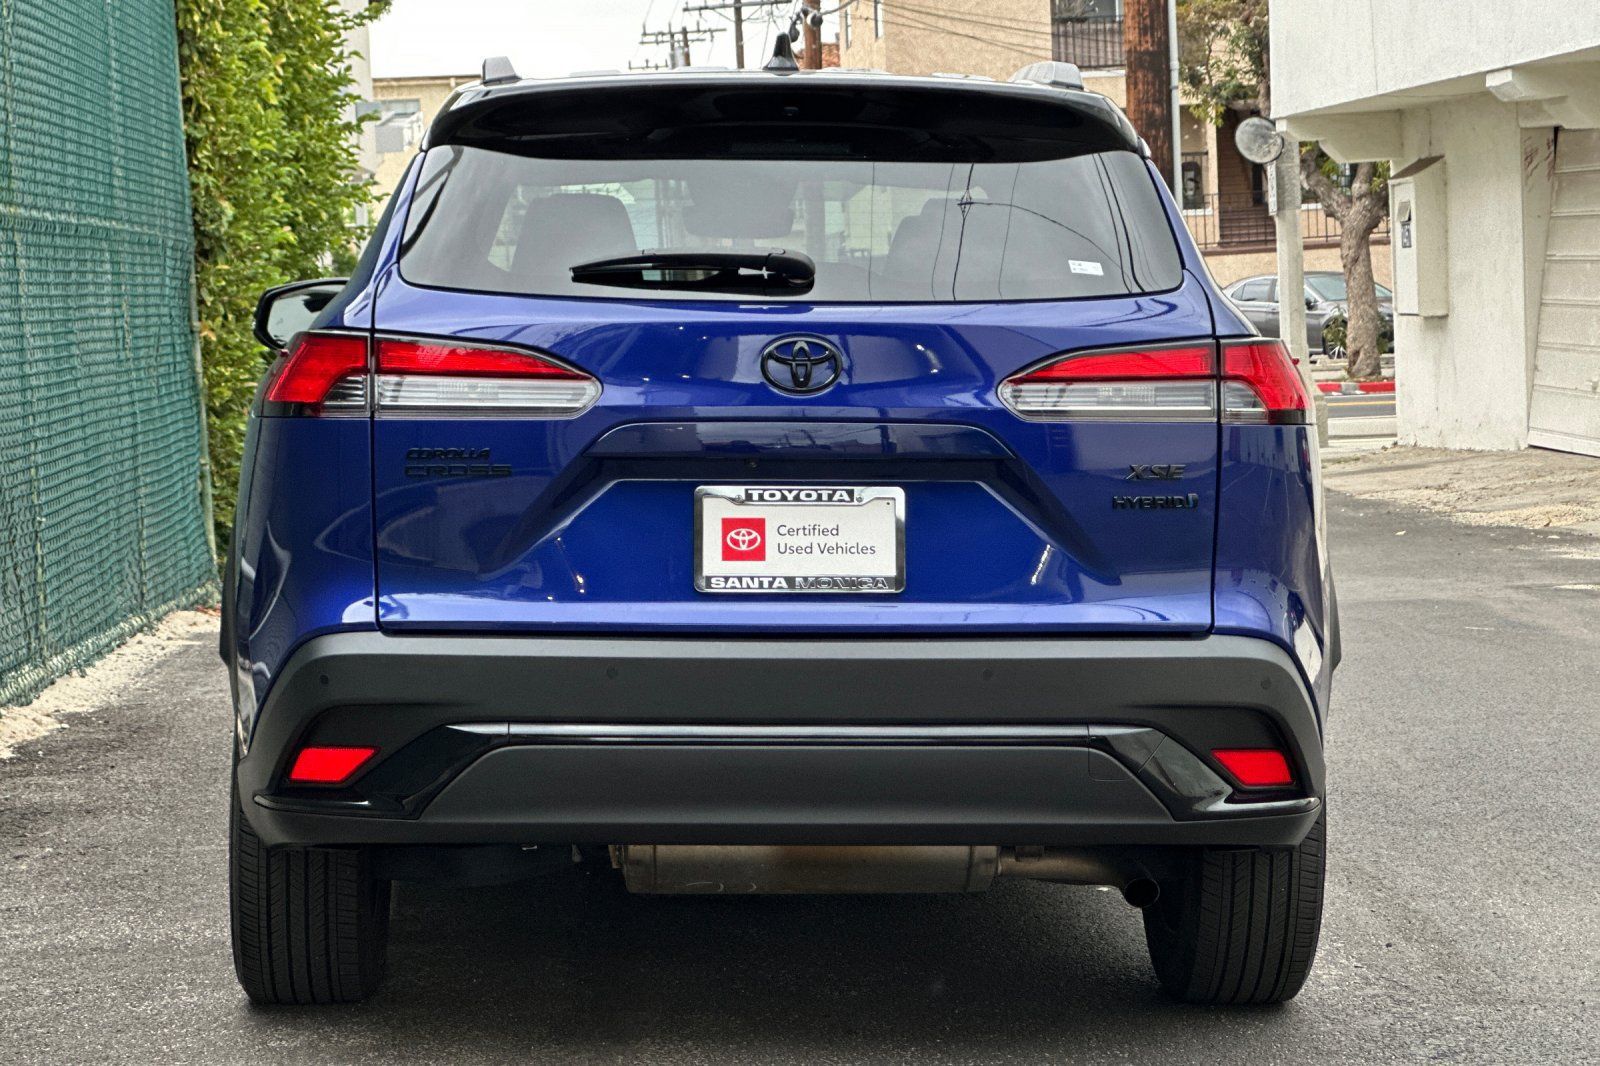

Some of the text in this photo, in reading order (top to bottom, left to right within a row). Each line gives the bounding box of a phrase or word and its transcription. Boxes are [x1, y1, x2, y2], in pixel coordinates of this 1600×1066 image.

[406, 447, 491, 459] COROLLA
[404, 464, 512, 477] CROSS
[1125, 464, 1186, 480] XSE
[748, 489, 850, 501] TOYOTA
[1112, 495, 1184, 509] HYBRID
[776, 523, 840, 537] Certified
[777, 542, 876, 555] Used Vehicles
[710, 576, 889, 590] SANTA MONICA
